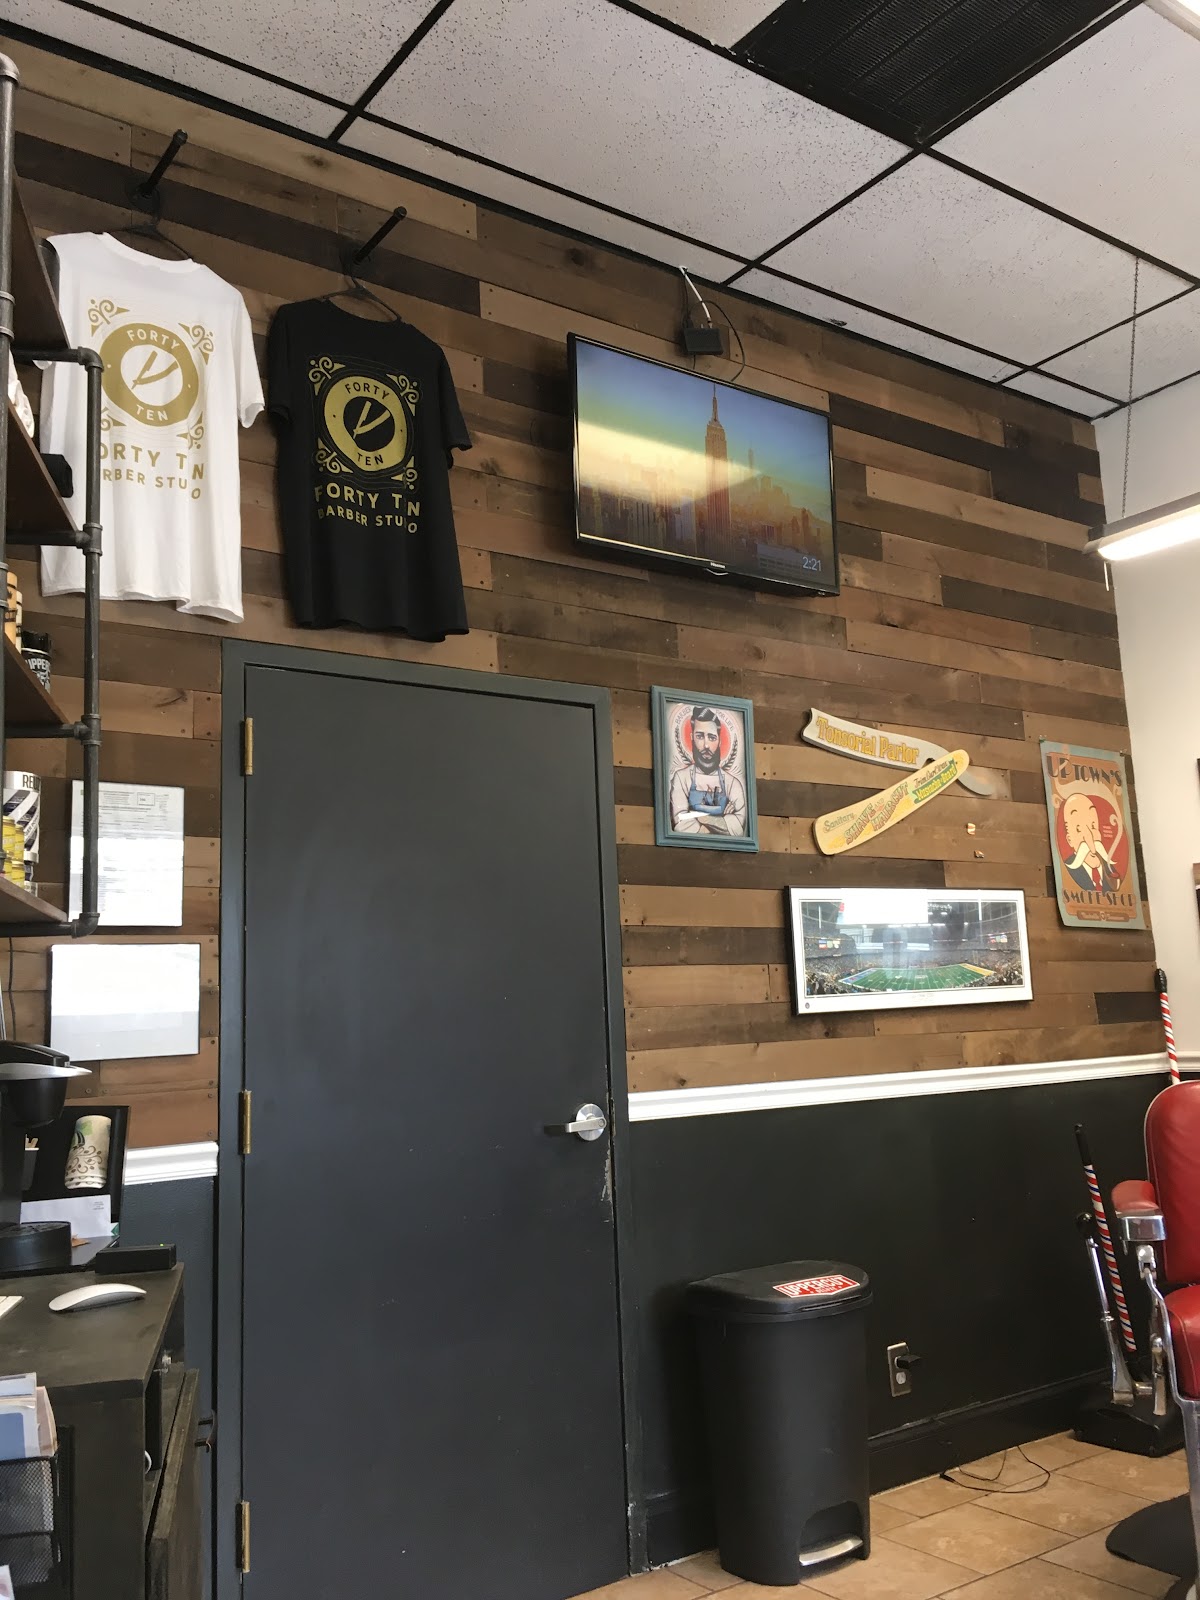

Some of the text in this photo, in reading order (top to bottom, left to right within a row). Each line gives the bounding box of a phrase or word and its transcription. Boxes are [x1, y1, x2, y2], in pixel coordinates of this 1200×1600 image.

[126, 329, 181, 350] FORTY
[344, 381, 390, 400] FORTY
[136, 404, 169, 421] TEN
[100, 442, 161, 467] ORTY
[356, 452, 384, 466] TEN
[102, 468, 146, 486] RBER
[314, 482, 379, 509] FORTY
[318, 505, 368, 527] BARBER
[802, 556, 822, 572] 2:21
[675, 706, 693, 725] BARBER
[816, 716, 920, 765] Tonsorial Parlor
[823, 812, 857, 833] Sanitary
[844, 803, 876, 845] SHAVE
[779, 1277, 852, 1296] UPPERCUT
